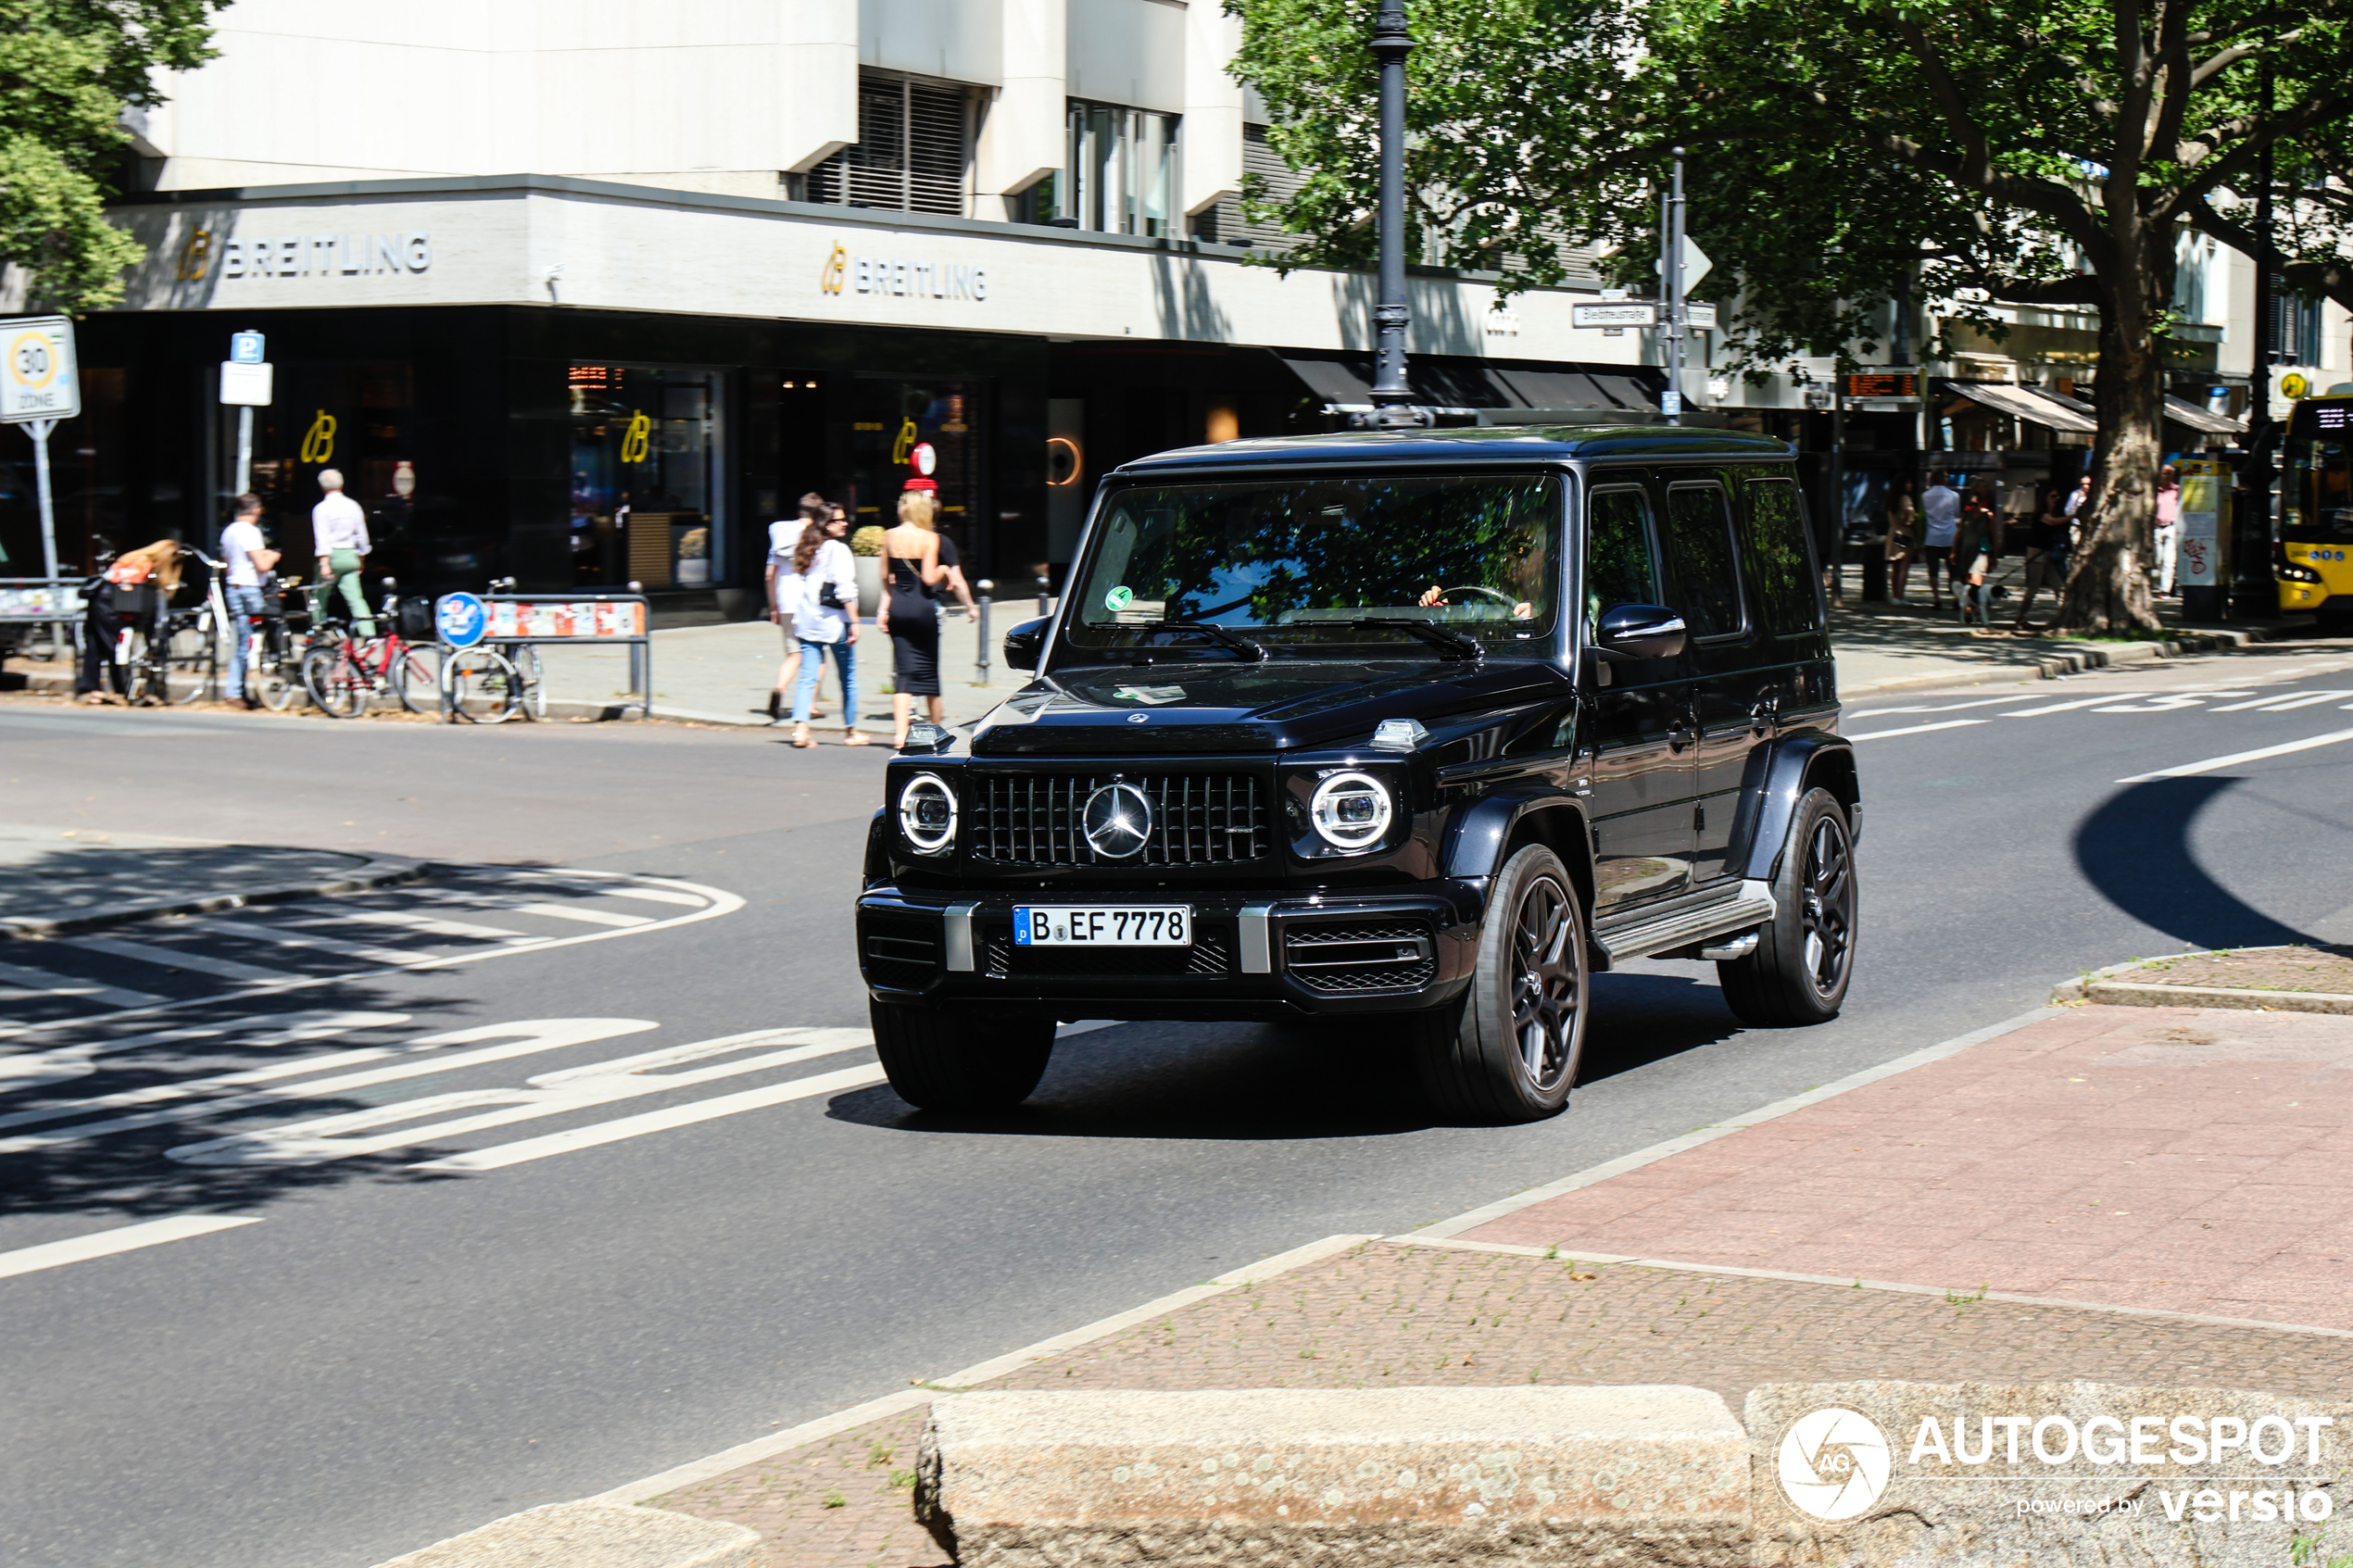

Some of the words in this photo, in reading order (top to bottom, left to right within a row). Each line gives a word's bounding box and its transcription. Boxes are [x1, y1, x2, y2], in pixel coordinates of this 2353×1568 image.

[223, 231, 433, 280] BREITLING
[855, 256, 988, 301] BREITLING
[239, 337, 258, 358] P
[18, 348, 48, 374] 30
[18, 394, 56, 410] ZONE
[1118, 589, 1129, 600] 4
[1020, 929, 1027, 939] D
[1032, 911, 1051, 940] B
[1070, 911, 1106, 940] EF
[1113, 911, 1184, 940] 7778
